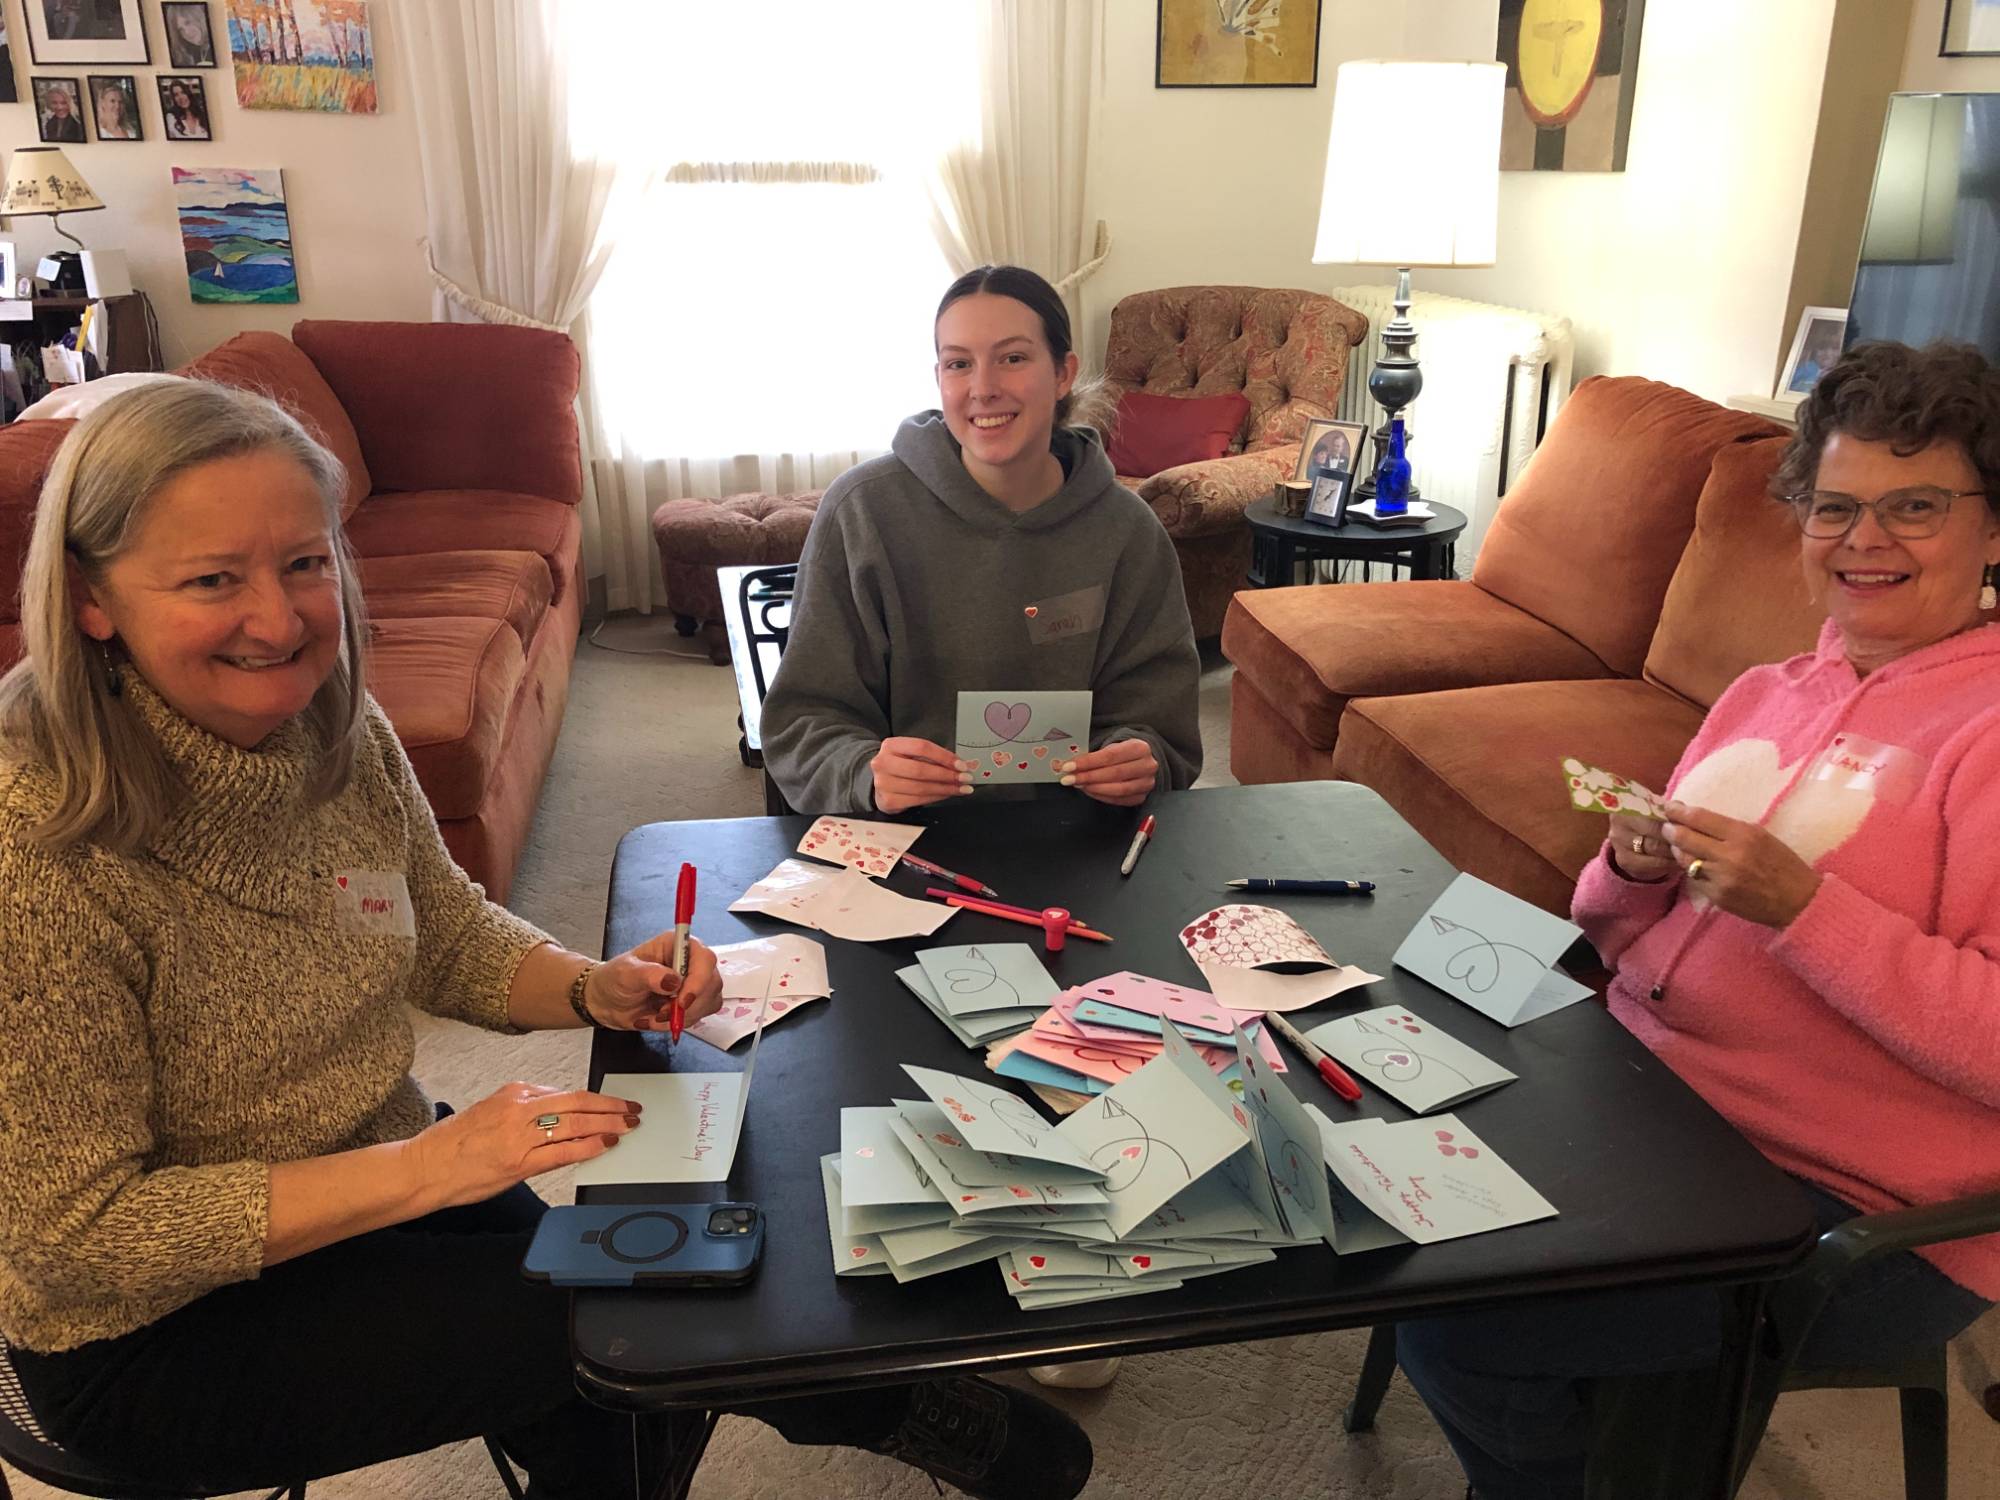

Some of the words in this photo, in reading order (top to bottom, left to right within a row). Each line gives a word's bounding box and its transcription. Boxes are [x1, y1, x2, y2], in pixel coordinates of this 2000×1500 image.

[361, 897, 394, 917] MARY
[695, 1081, 720, 1102] Happy
[680, 1145, 713, 1162] Day
[1408, 1175, 1432, 1202] Day
